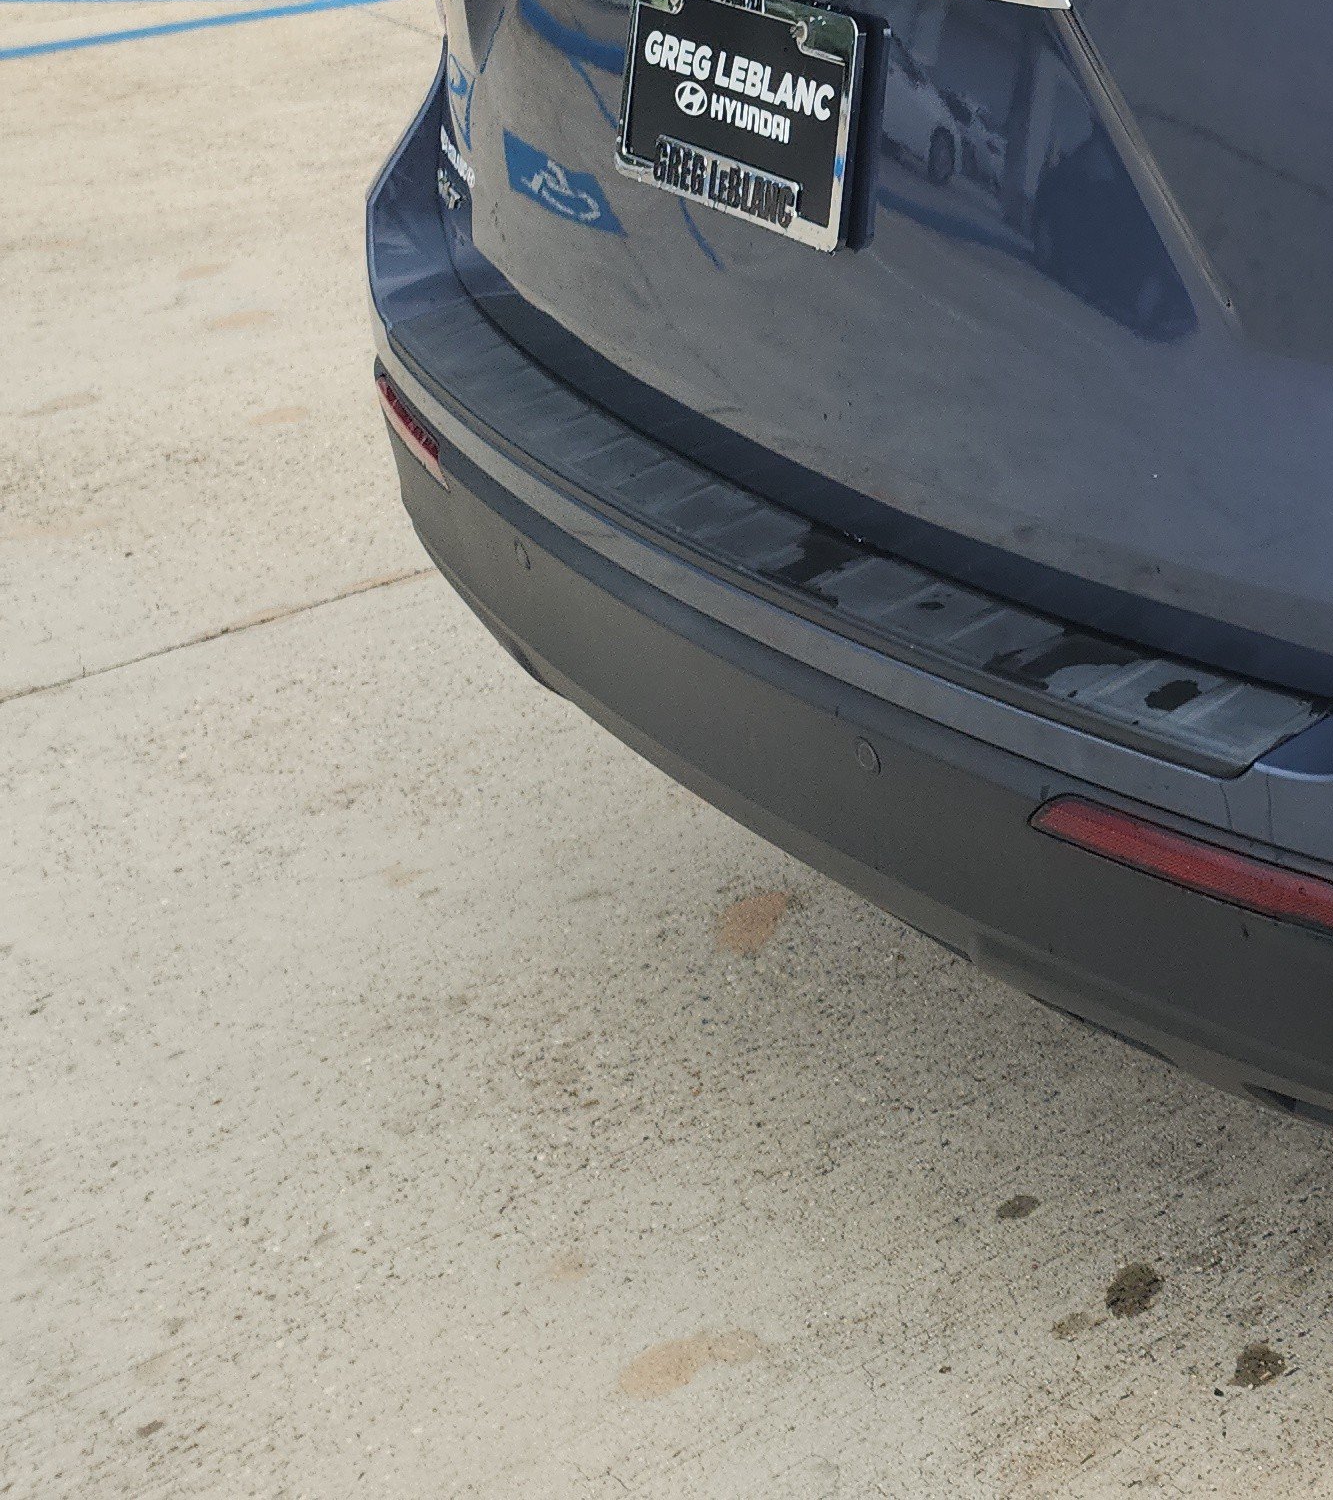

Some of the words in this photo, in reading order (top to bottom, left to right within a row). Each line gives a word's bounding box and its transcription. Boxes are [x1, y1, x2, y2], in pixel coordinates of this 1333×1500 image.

[644, 30, 713, 80] GREG
[714, 51, 835, 121] LEBLANC
[710, 94, 790, 144] HYUNDAI
[653, 140, 708, 197] GREG
